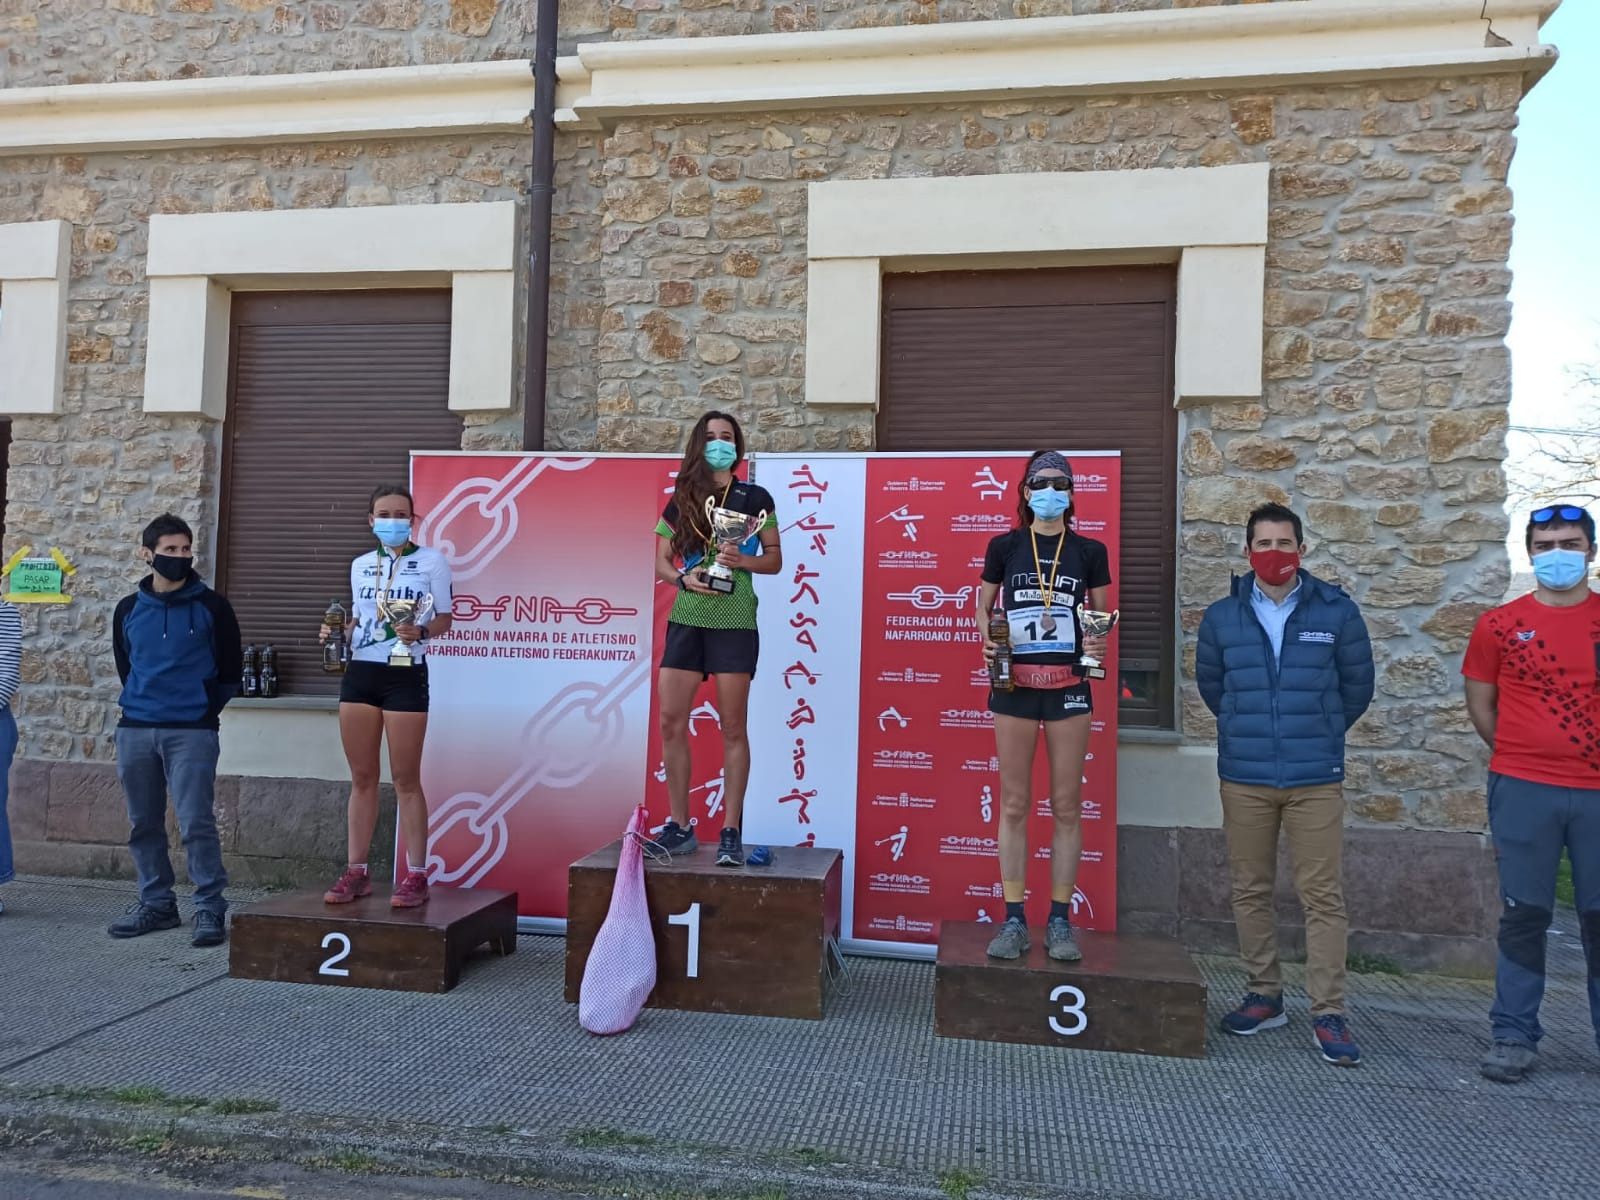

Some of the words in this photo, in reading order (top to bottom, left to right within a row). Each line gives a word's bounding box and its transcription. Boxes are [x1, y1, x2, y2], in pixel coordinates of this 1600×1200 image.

[886, 614, 952, 627] FEDERACIÓN
[434, 627, 490, 641] ERACIÓN
[493, 630, 548, 643] NAVARRA
[552, 632, 567, 644] DE
[571, 632, 637, 645] ATLETISMO
[885, 630, 951, 642] NAFARROAKO
[954, 631, 983, 643] ATLET
[1024, 621, 1058, 641] 12
[425, 645, 488, 657] AFARROAKO
[491, 646, 550, 659] ATLETISMO
[553, 648, 636, 661] FEDERAKUNTZA
[667, 902, 700, 977] 1
[318, 931, 352, 977] 2
[1048, 984, 1088, 1036] 3
